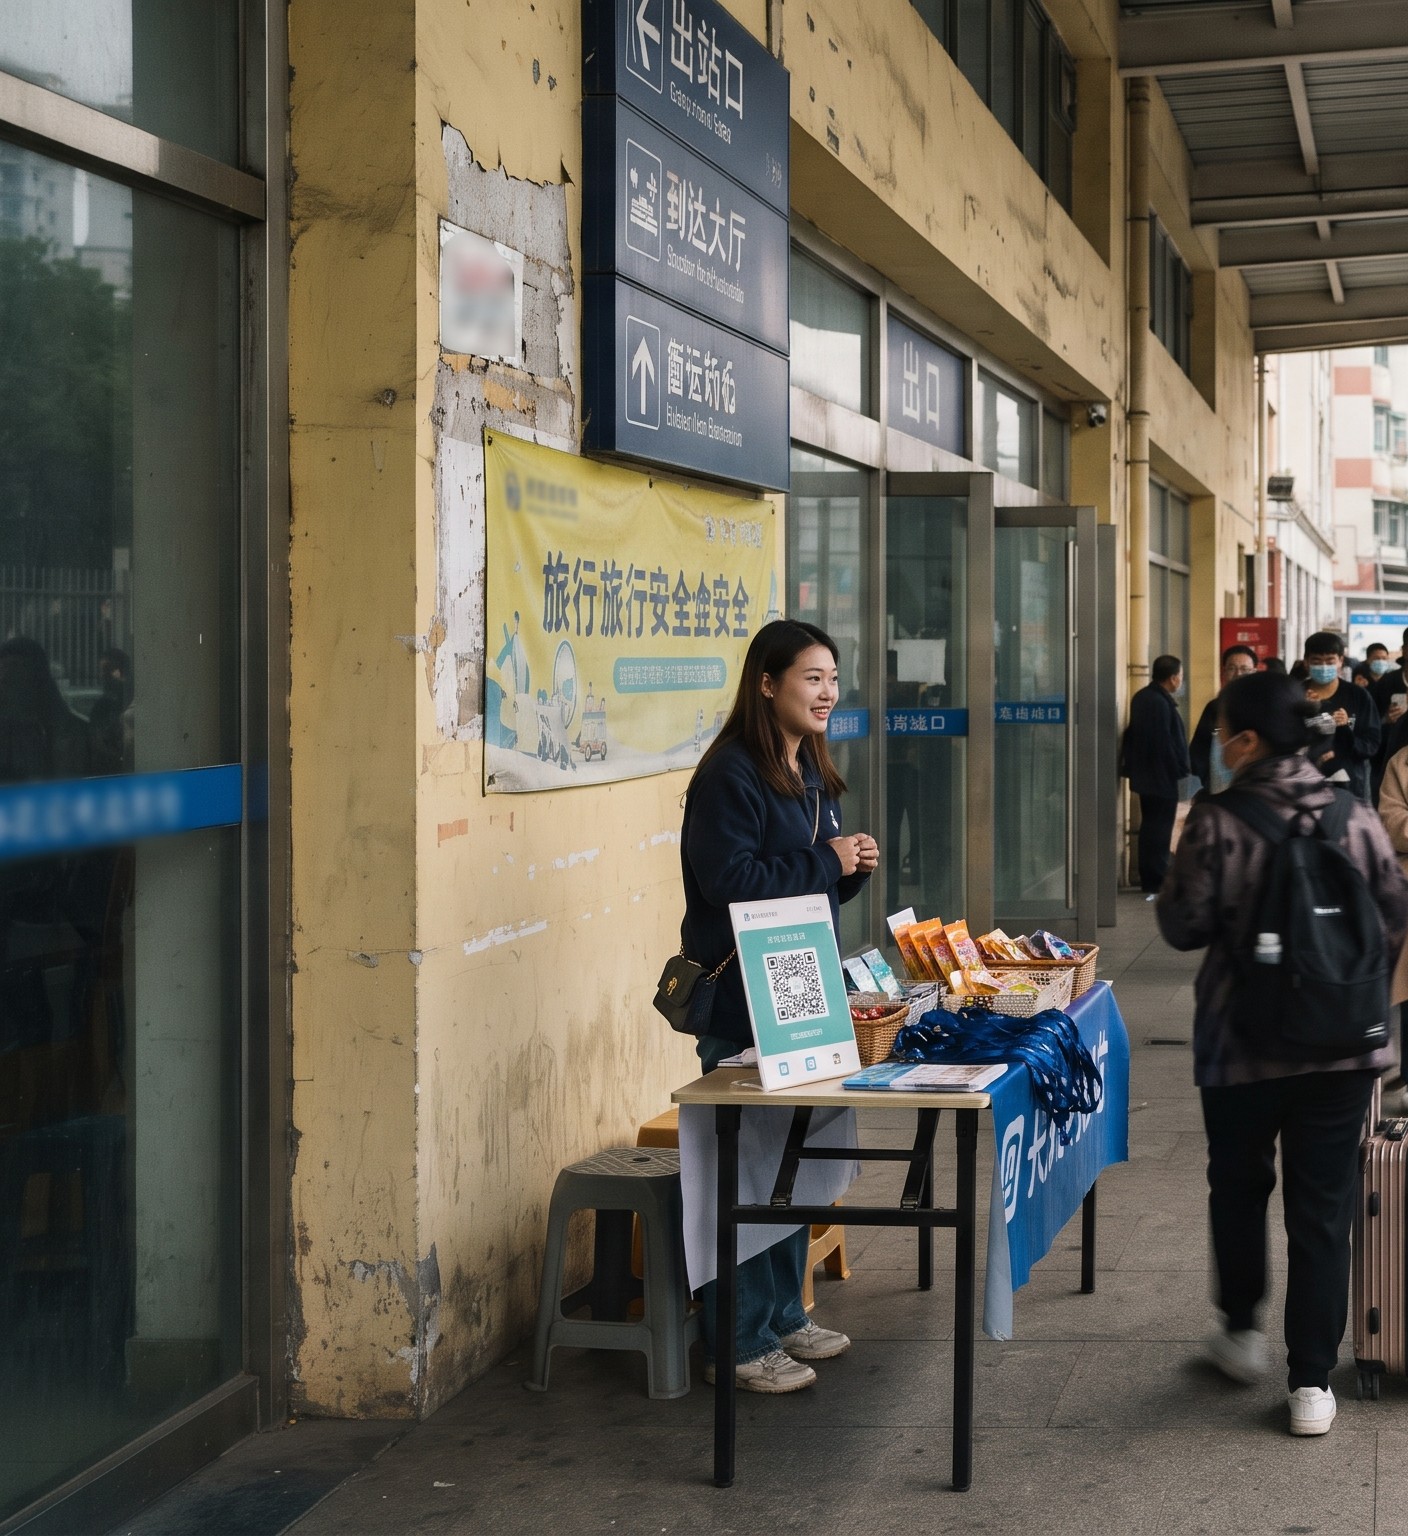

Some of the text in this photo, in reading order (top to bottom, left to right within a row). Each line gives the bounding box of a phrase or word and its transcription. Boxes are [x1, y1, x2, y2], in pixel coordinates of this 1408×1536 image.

[671, 0, 743, 120] 出站口
[666, 170, 746, 272] 到达大厅
[903, 341, 940, 430] 出口
